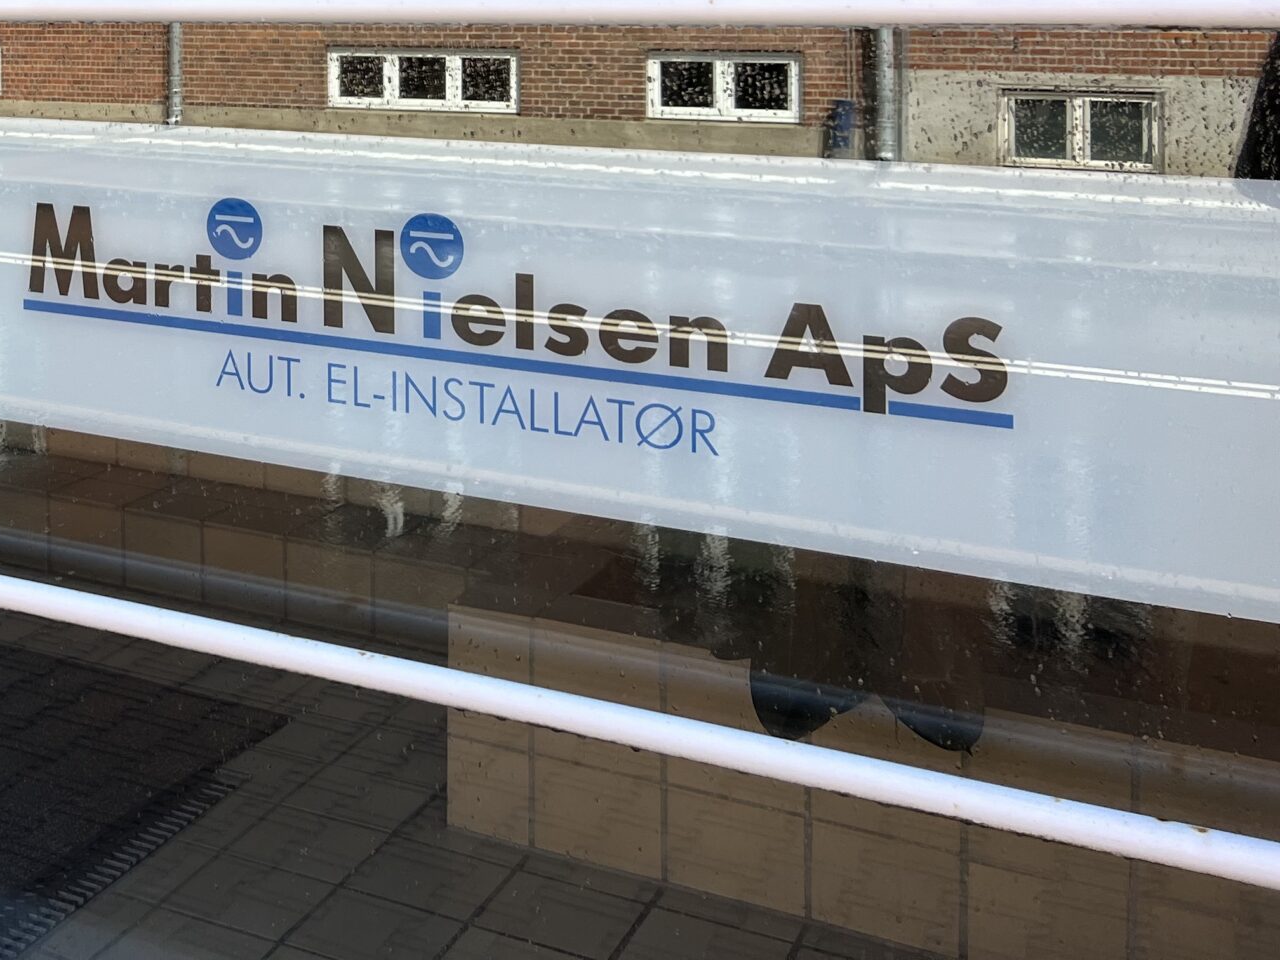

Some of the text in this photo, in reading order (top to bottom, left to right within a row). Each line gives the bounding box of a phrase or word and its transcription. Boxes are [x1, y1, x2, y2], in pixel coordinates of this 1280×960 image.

[28, 198, 1009, 414] Martin Nielsen ApS
[217, 350, 720, 457] AUT. EL-INSTALLATØR
